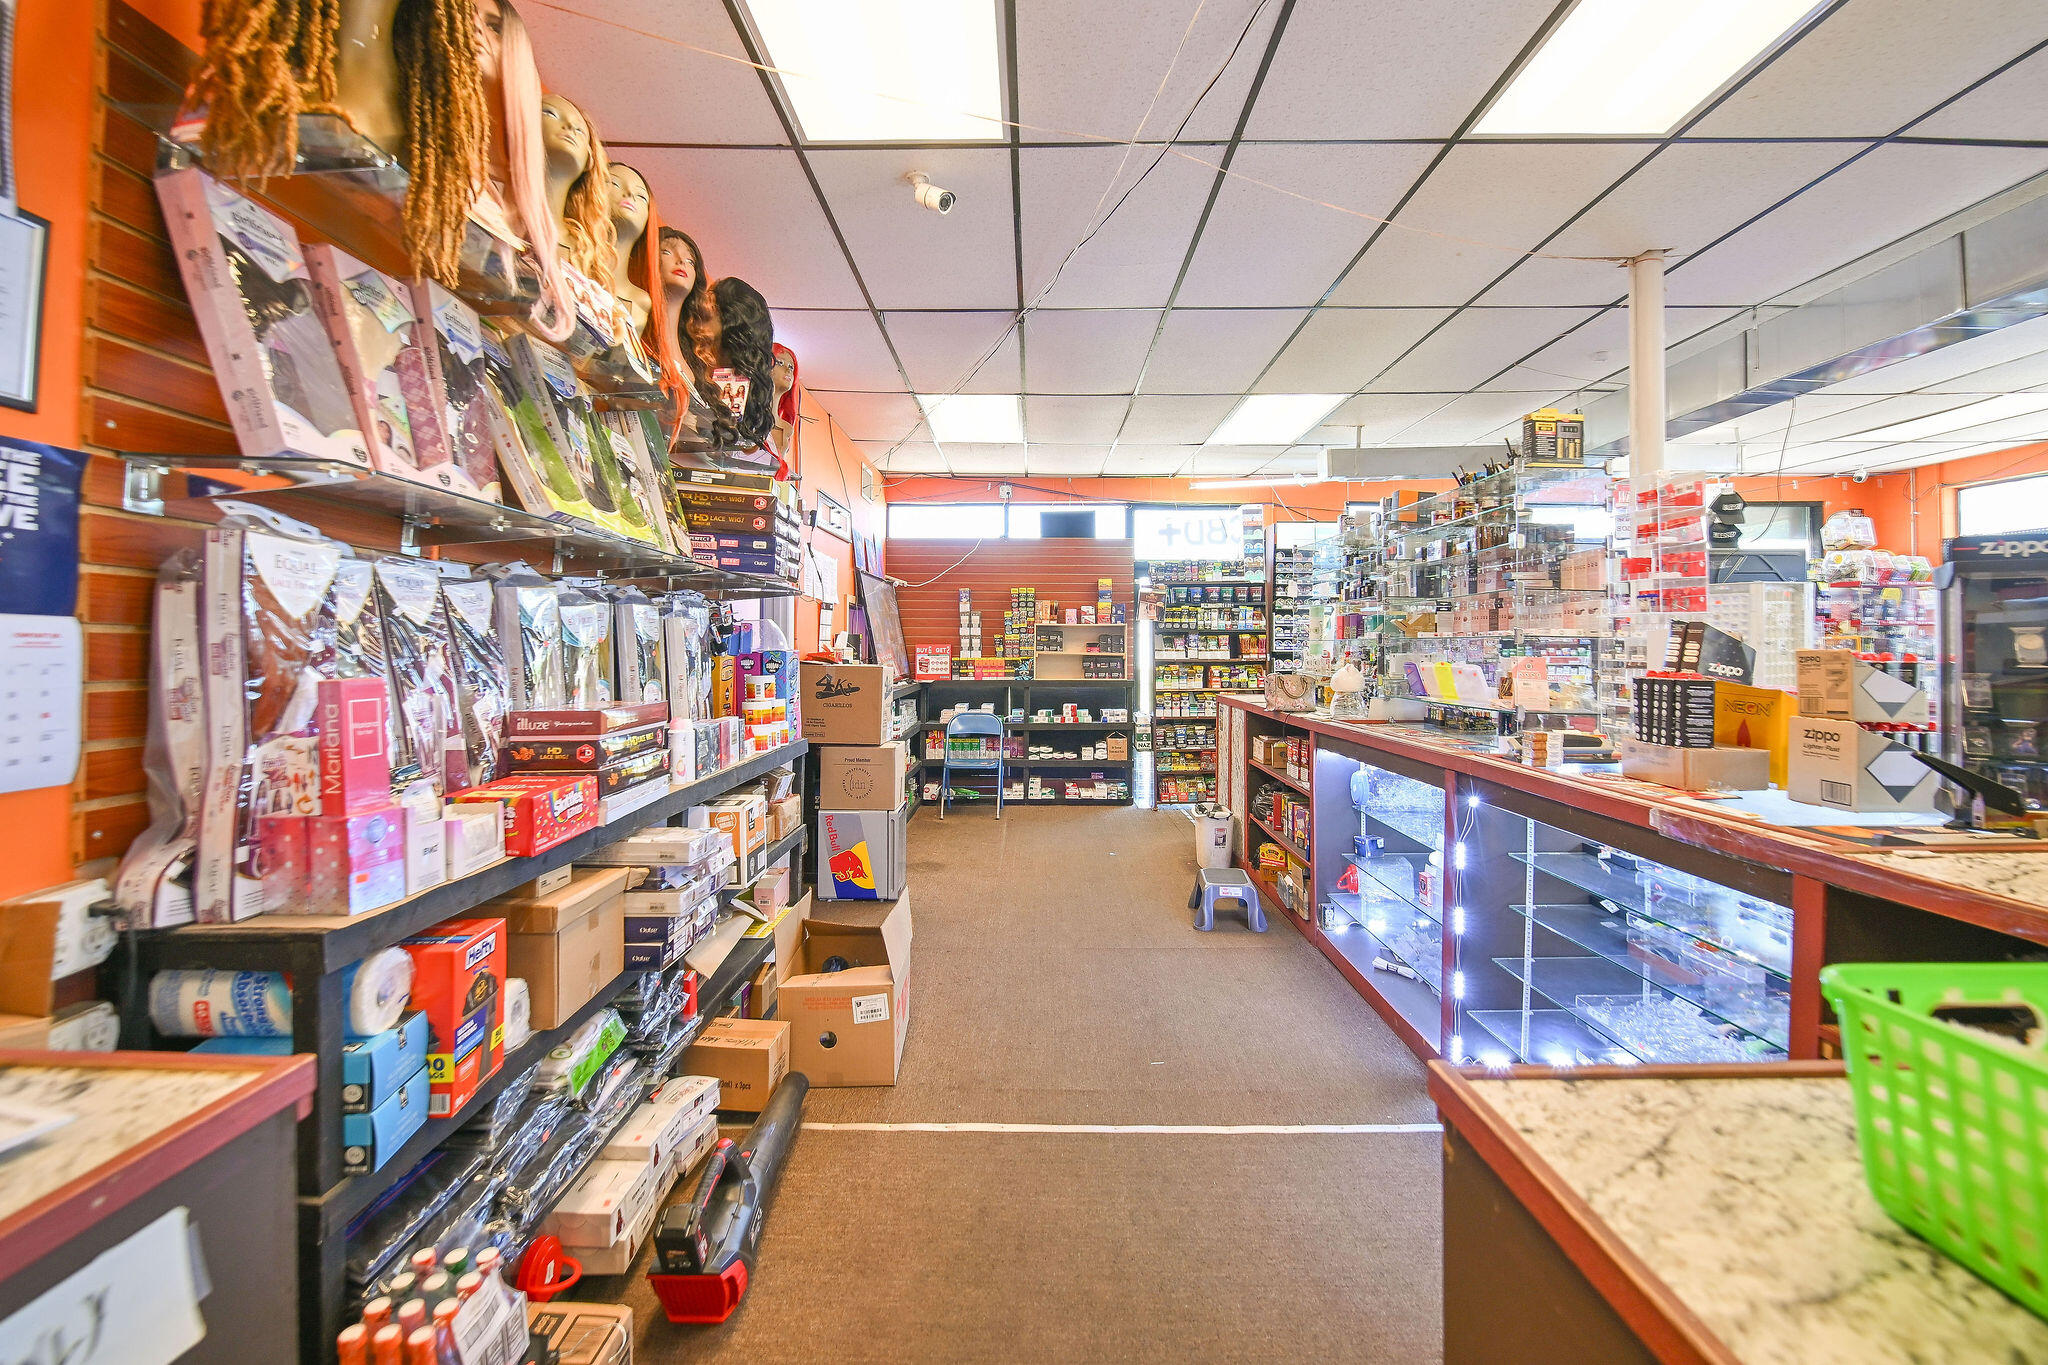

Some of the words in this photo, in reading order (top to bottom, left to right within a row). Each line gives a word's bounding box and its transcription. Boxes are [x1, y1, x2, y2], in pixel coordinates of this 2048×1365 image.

[694, 513, 709, 522] HD
[1708, 662, 1744, 678] zippo
[1723, 699, 1772, 717] NEON
[516, 718, 550, 731] illuze
[1803, 729, 1841, 744] zippo
[547, 747, 562, 755] HD
[825, 815, 837, 833] Red
[829, 834, 841, 852] Bull
[467, 937, 496, 963] Hefty
